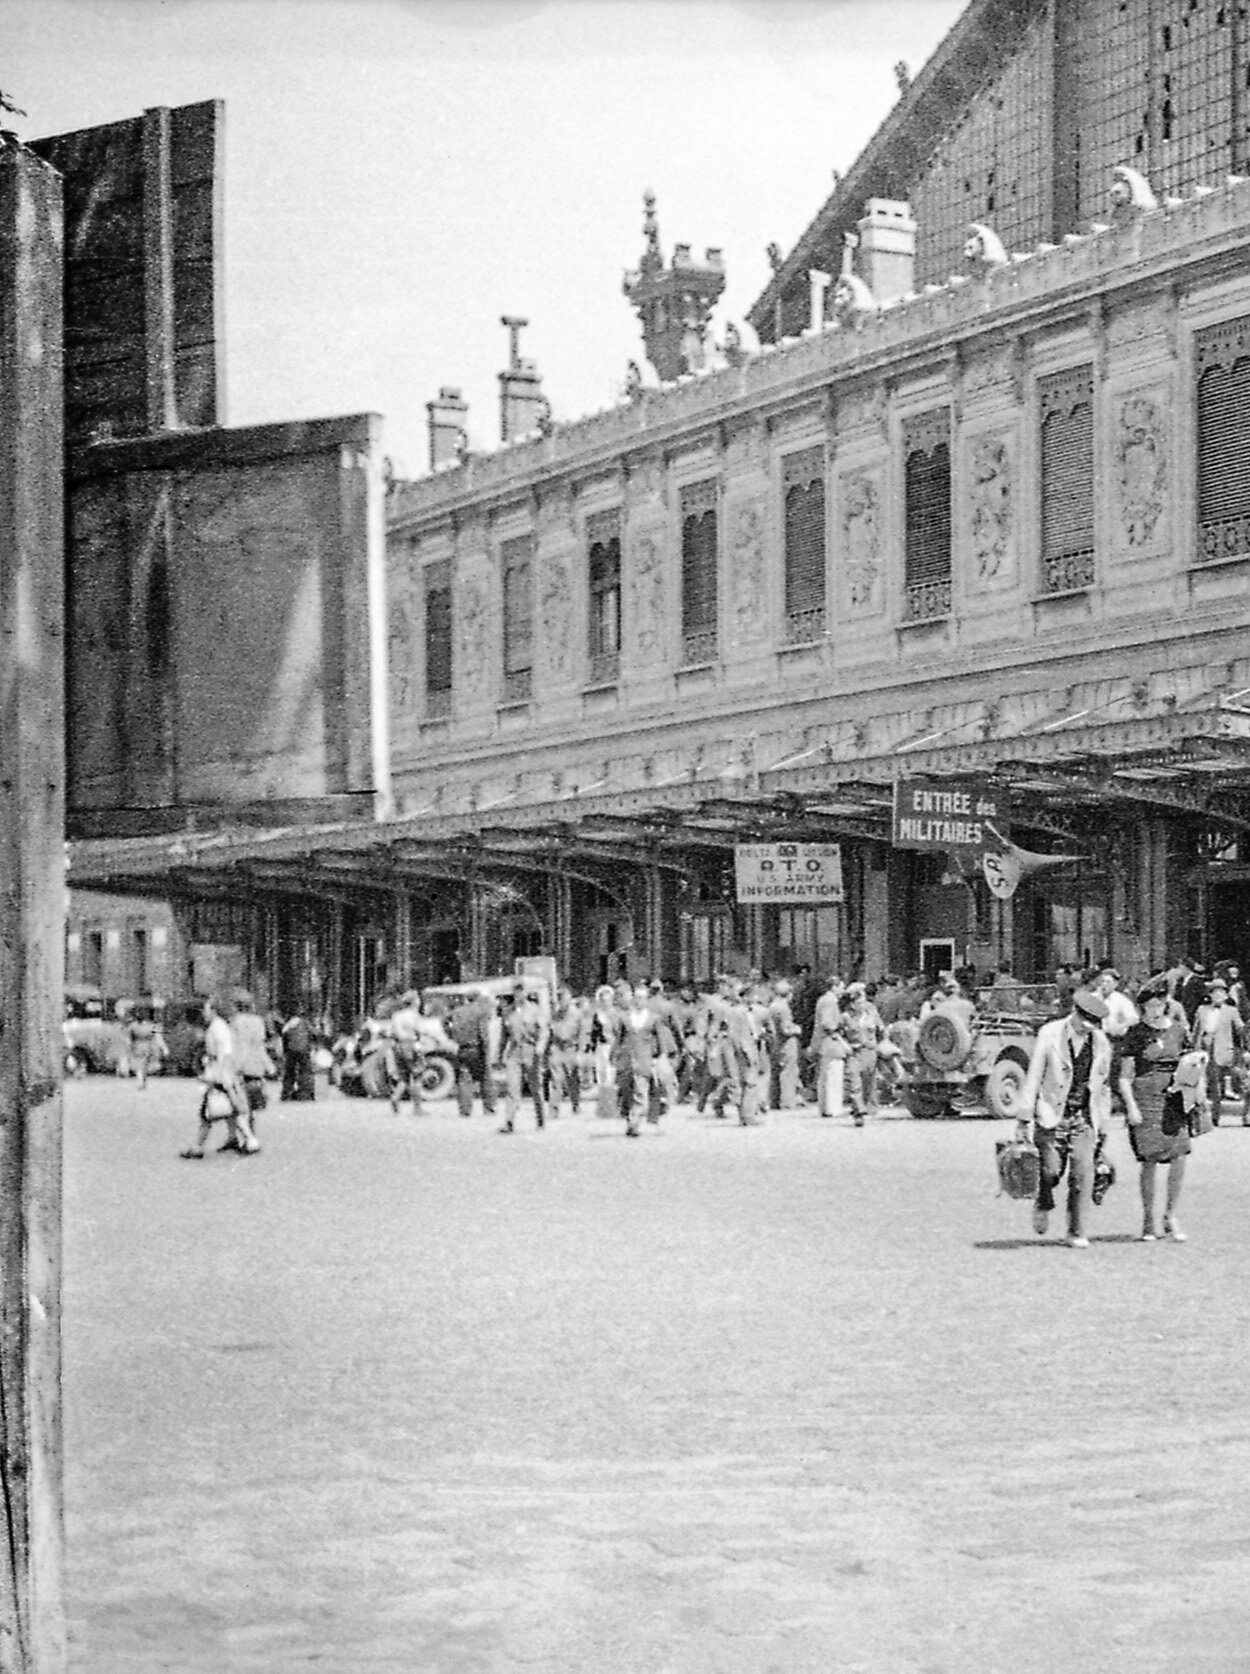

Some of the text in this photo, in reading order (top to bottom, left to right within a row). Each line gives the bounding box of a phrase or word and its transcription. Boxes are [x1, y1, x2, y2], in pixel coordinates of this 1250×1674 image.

[912, 790, 996, 816] ENTRÉE des
[900, 818, 982, 844] MILITAIRES
[742, 885, 841, 896] INFORMATION
